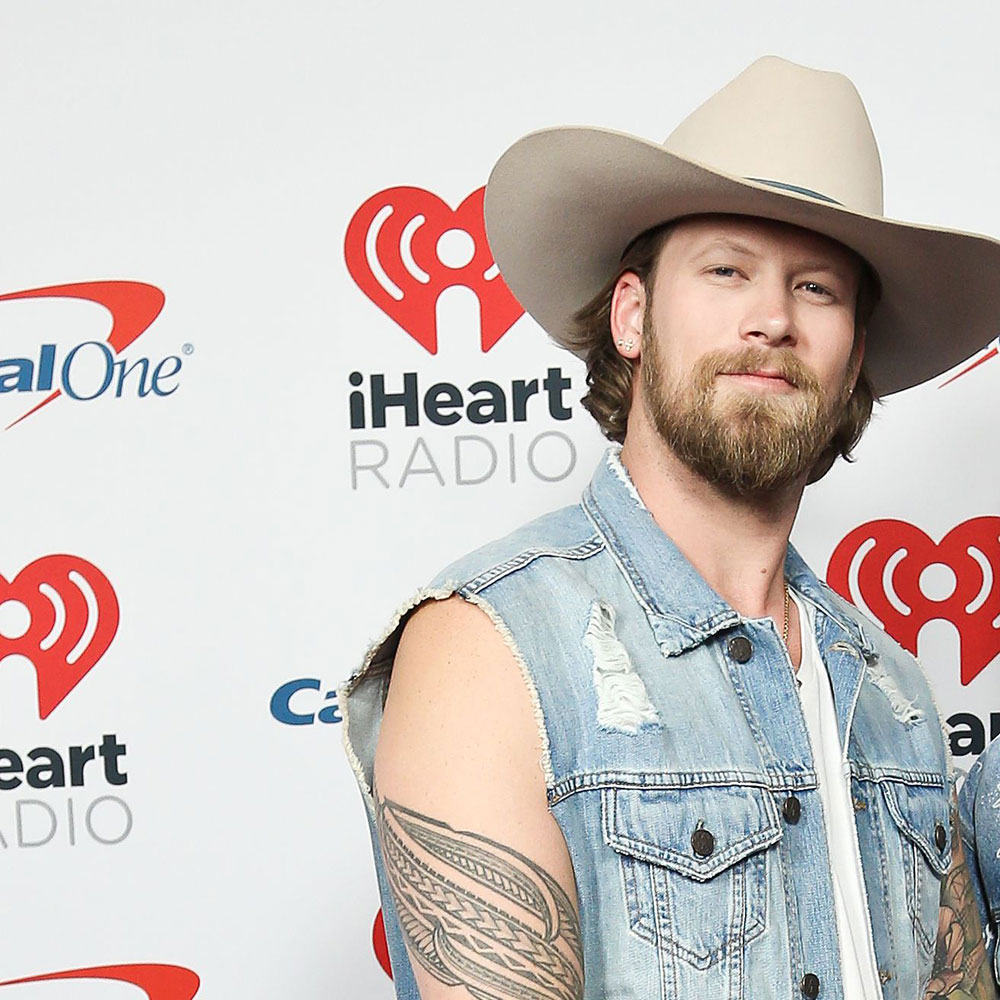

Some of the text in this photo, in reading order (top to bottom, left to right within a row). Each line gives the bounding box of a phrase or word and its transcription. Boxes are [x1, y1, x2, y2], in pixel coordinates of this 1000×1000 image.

[348, 367, 572, 430] iHeart
[350, 431, 577, 490] RADIO
[0, 796, 132, 849] DIO
